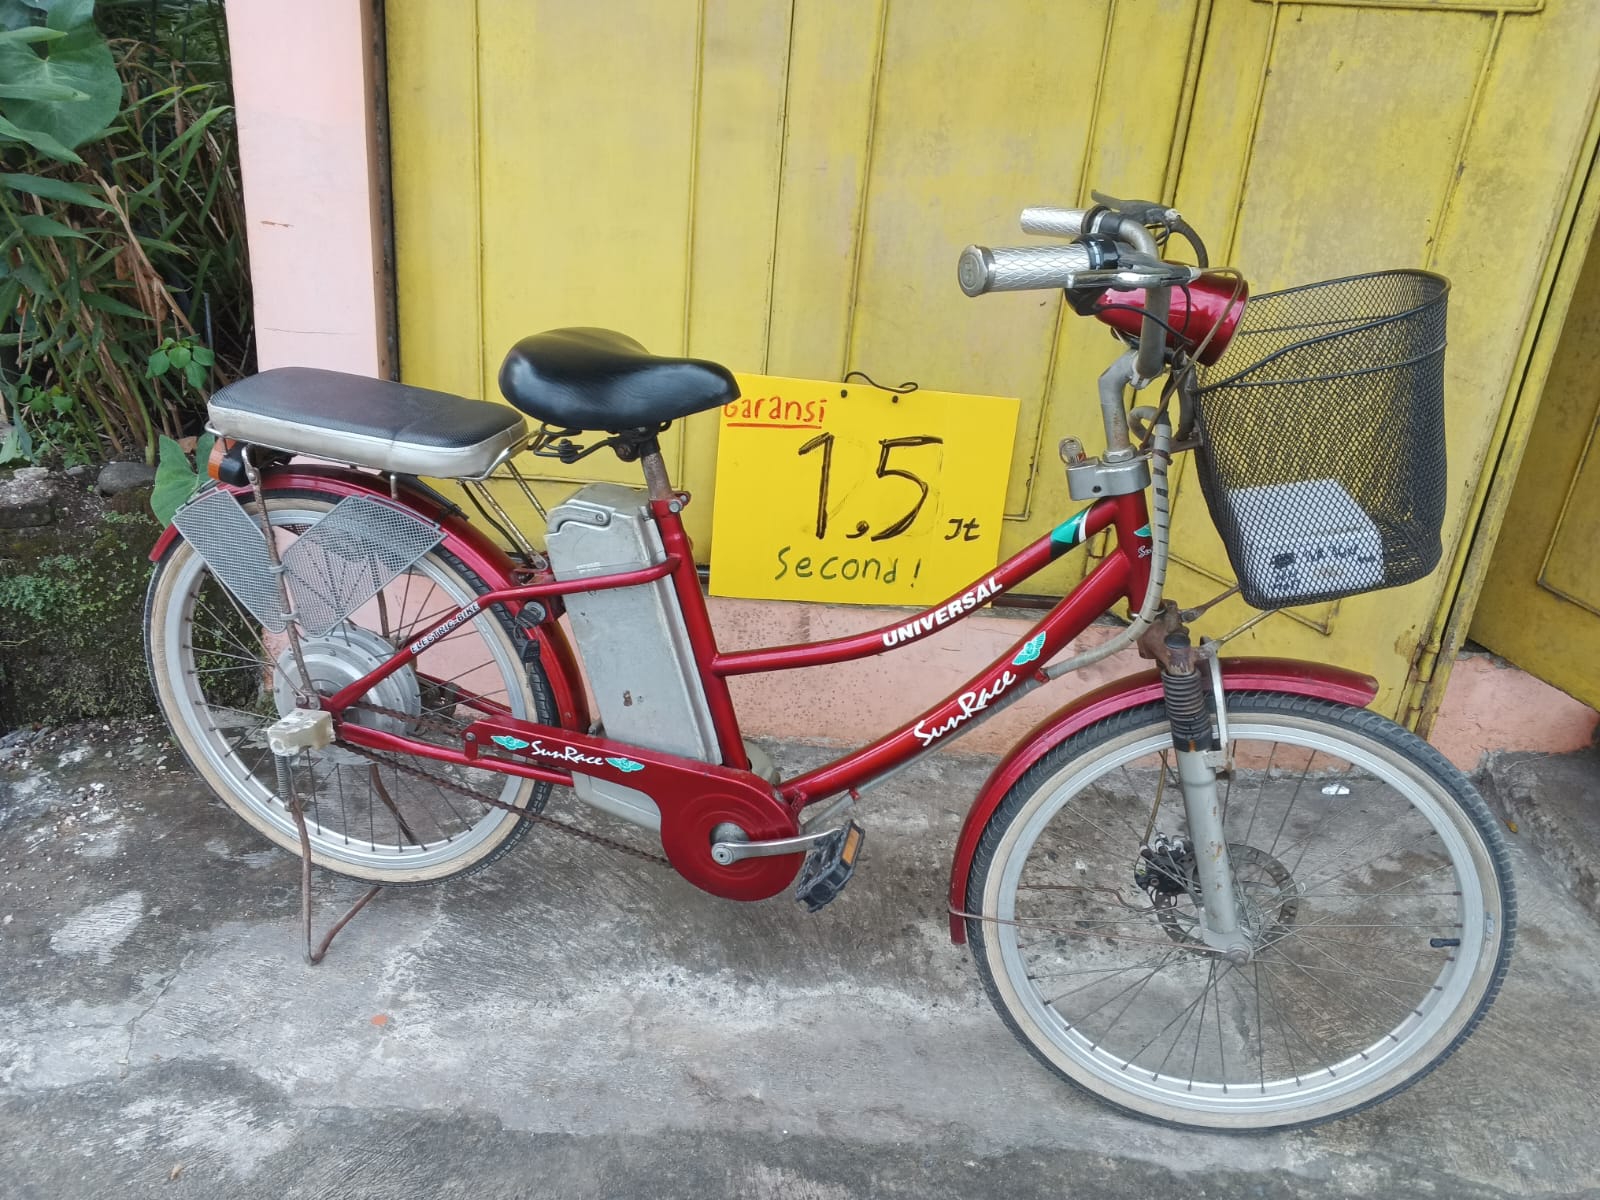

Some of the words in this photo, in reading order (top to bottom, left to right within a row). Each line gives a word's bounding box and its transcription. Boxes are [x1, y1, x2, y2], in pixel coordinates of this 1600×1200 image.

[724, 396, 827, 422] Garansi
[798, 431, 943, 541] 1,5
[411, 603, 479, 652] ELECTRIC-BIKE
[882, 577, 1003, 647] UNIVERSAL
[913, 671, 1016, 746] SunRace
[531, 740, 604, 766] SunRace
